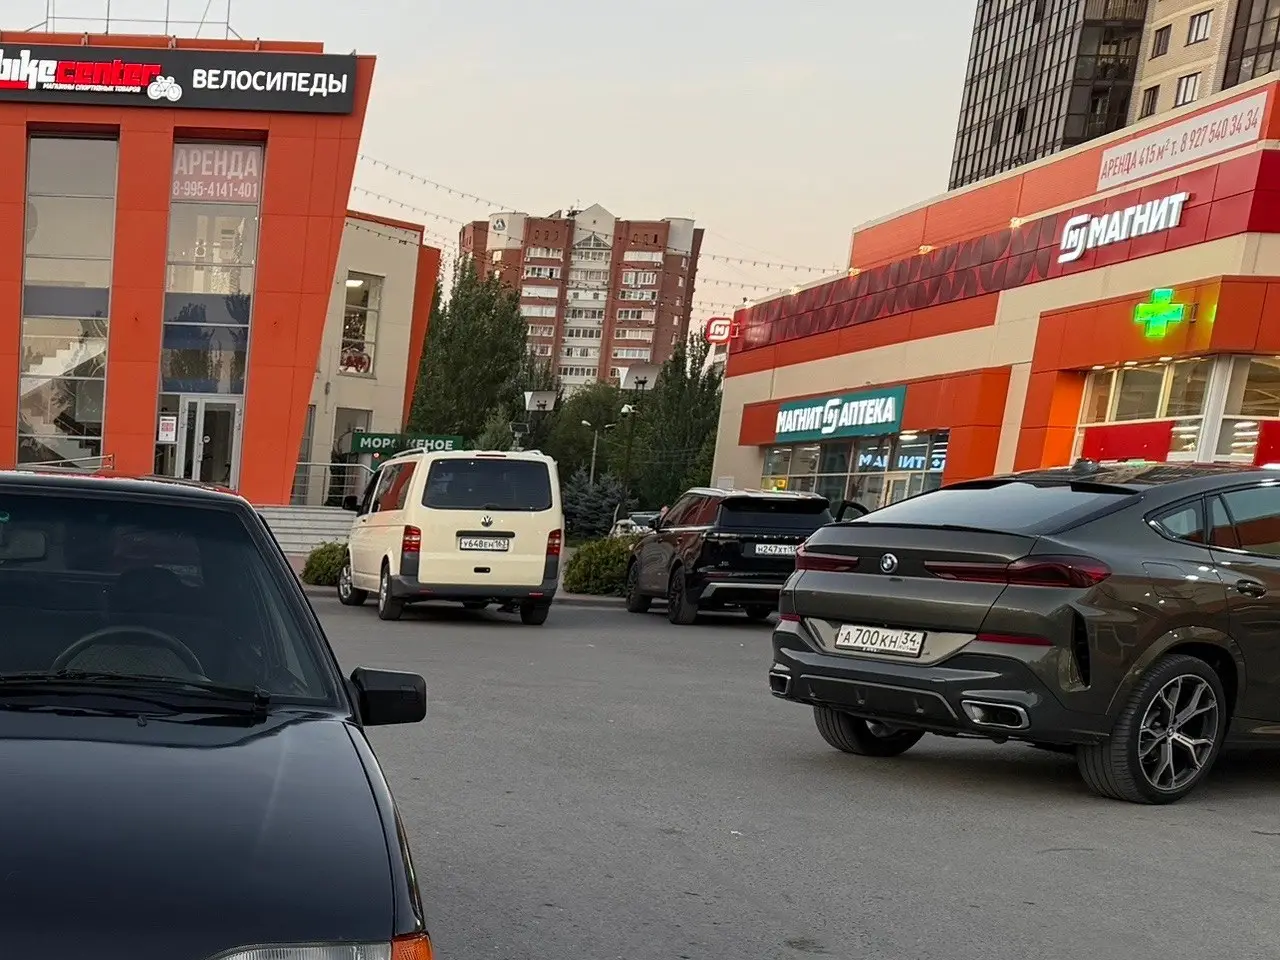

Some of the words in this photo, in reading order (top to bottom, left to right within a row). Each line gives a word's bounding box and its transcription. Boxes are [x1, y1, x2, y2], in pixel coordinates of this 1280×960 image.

[192, 68, 348, 97] ВЕЛОСИПЕДЫ
[1101, 148, 1137, 180] АРЕНДА
[1138, 144, 1156, 168] 415
[1179, 132, 1189, 153] 8
[1188, 125, 1208, 151] 927
[1208, 120, 1228, 144] 540
[1229, 112, 1244, 137] 34
[1244, 106, 1260, 131] 34
[175, 149, 258, 179] АРЕНДА
[172, 180, 258, 198] 8-995-4141-401
[1086, 191, 1190, 249] МАГНИТ
[775, 405, 823, 433] МАГНИТ
[838, 397, 896, 427] АПТЕКА
[901, 632, 917, 646] 34
